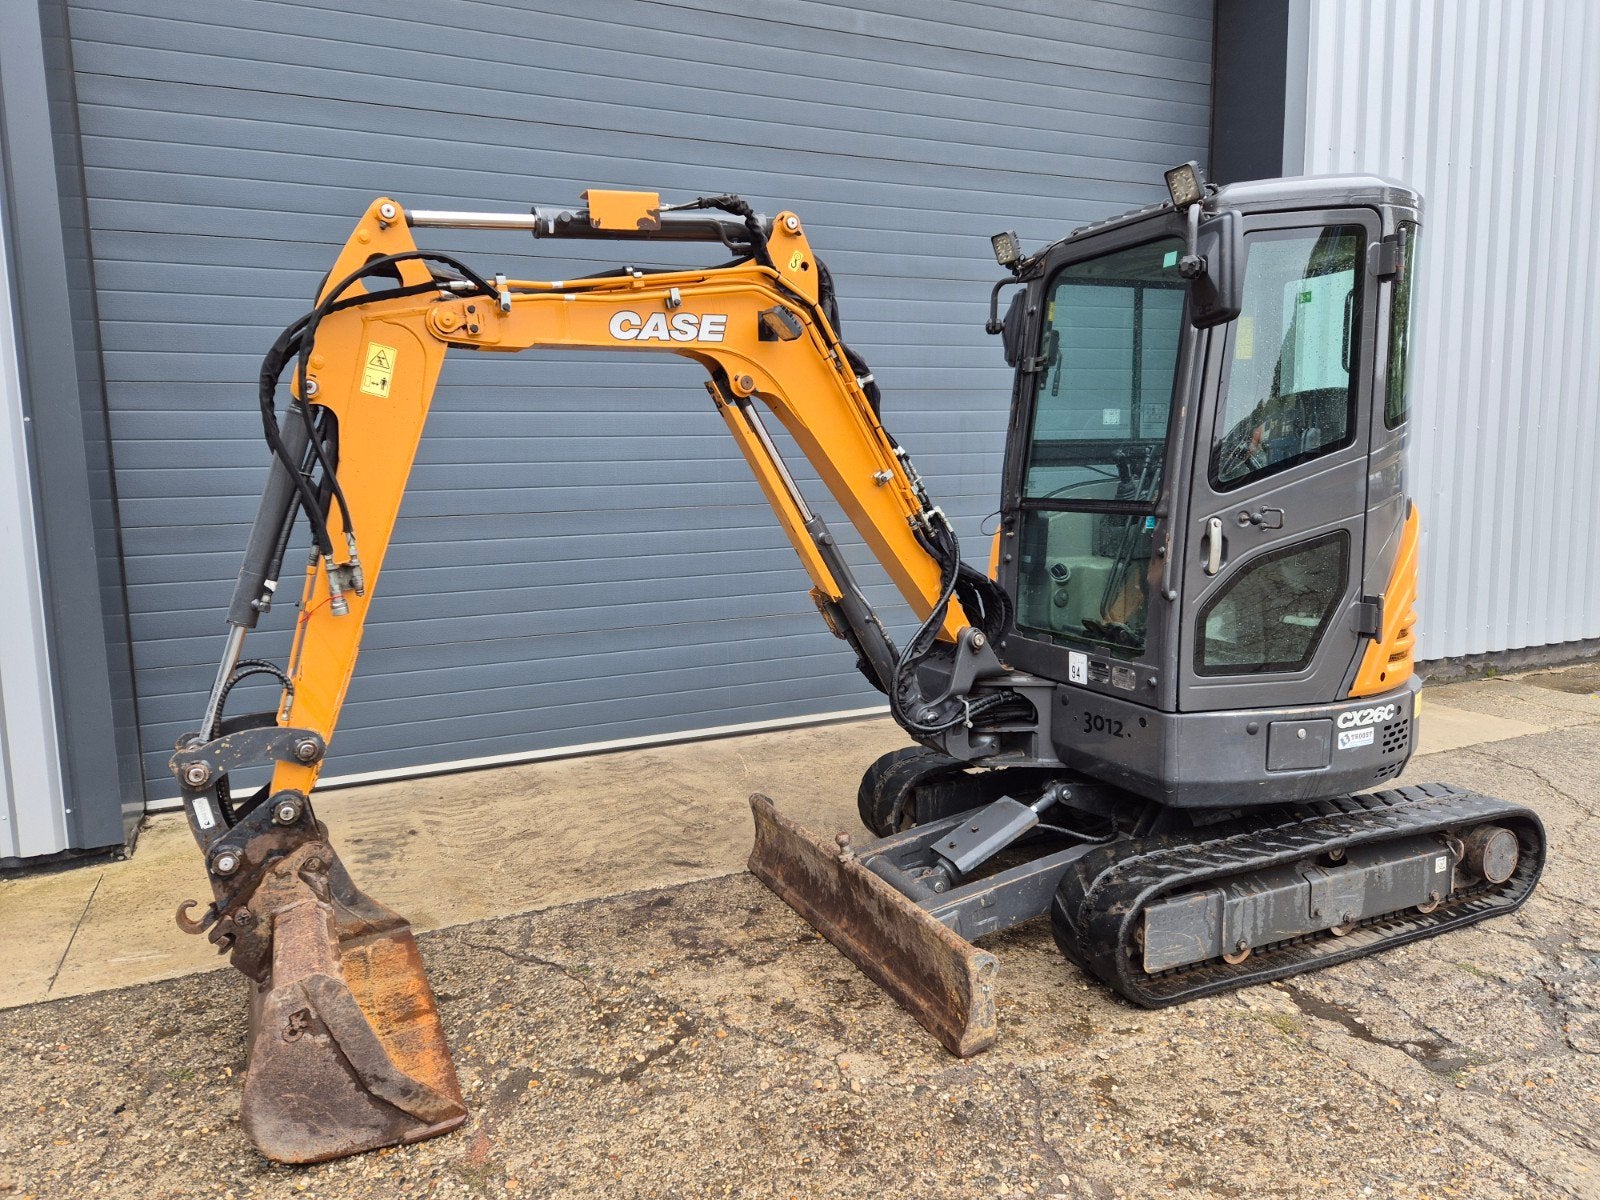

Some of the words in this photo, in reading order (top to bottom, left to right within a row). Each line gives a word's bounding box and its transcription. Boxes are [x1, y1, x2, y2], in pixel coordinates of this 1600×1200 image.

[608, 310, 728, 342] CASE
[1071, 665, 1081, 680] 94
[1083, 711, 1124, 738] 3012
[1337, 703, 1395, 729] CX26C
